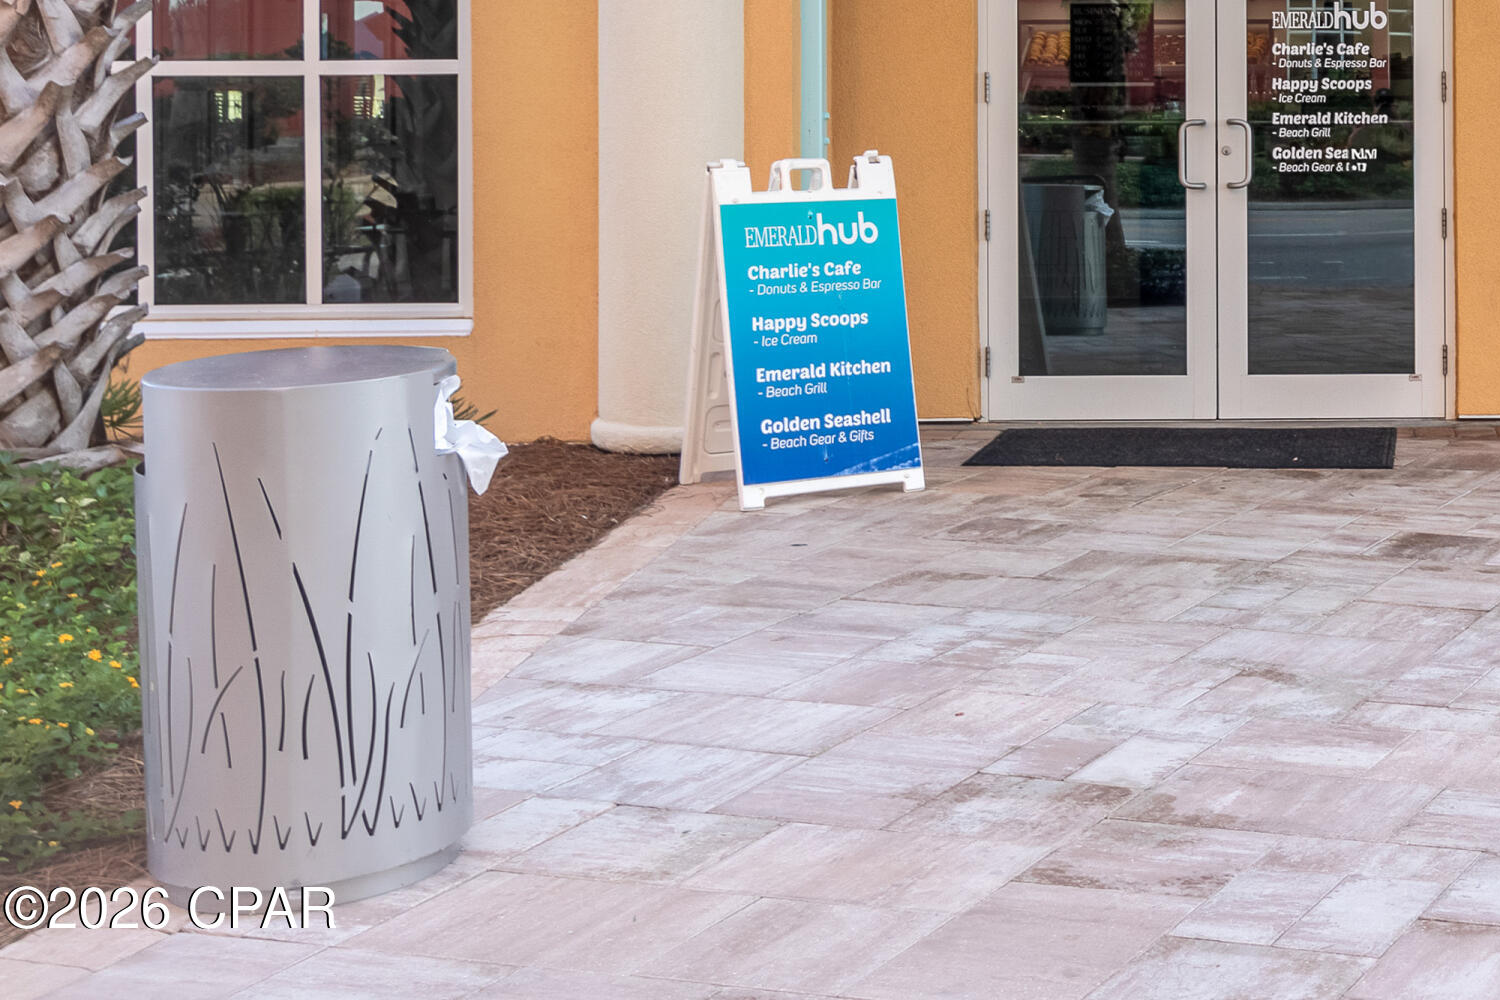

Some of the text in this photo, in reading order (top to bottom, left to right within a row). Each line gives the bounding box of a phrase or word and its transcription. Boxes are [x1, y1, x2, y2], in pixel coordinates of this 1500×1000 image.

[1272, 42, 1370, 56] Charlie's Cafe
[1278, 58, 1313, 68] Donuts
[1314, 58, 1322, 68] &
[1324, 58, 1367, 70] Espresso
[1369, 58, 1387, 68] Bar
[1272, 77, 1372, 93] Happy Scoops
[1278, 93, 1293, 103] Ice
[1294, 93, 1326, 103] Cream
[1272, 111, 1388, 125] Emerald Kitchen
[1278, 127, 1310, 138] Beach
[1311, 127, 1331, 138] Grill
[1272, 146, 1323, 160] Golden
[1279, 162, 1310, 173] Beach
[1311, 162, 1335, 172] Gear
[1336, 162, 1344, 172] &
[747, 260, 861, 280] Charlie's Cafe
[757, 283, 797, 295] Donuts
[800, 281, 808, 293] &
[811, 280, 860, 294] Espresso
[863, 278, 882, 290] Bar
[752, 312, 869, 333] Happy Scoops
[761, 335, 778, 347] Ice
[780, 334, 818, 346] Cream
[756, 360, 891, 382] Emerald Kitchen
[766, 384, 802, 398] Beach
[805, 382, 827, 395] Grill
[761, 408, 891, 434] Golden Seashell
[770, 435, 807, 450] Beach
[809, 433, 836, 446] Gear
[838, 431, 847, 443] &
[849, 429, 875, 443] Gifts
